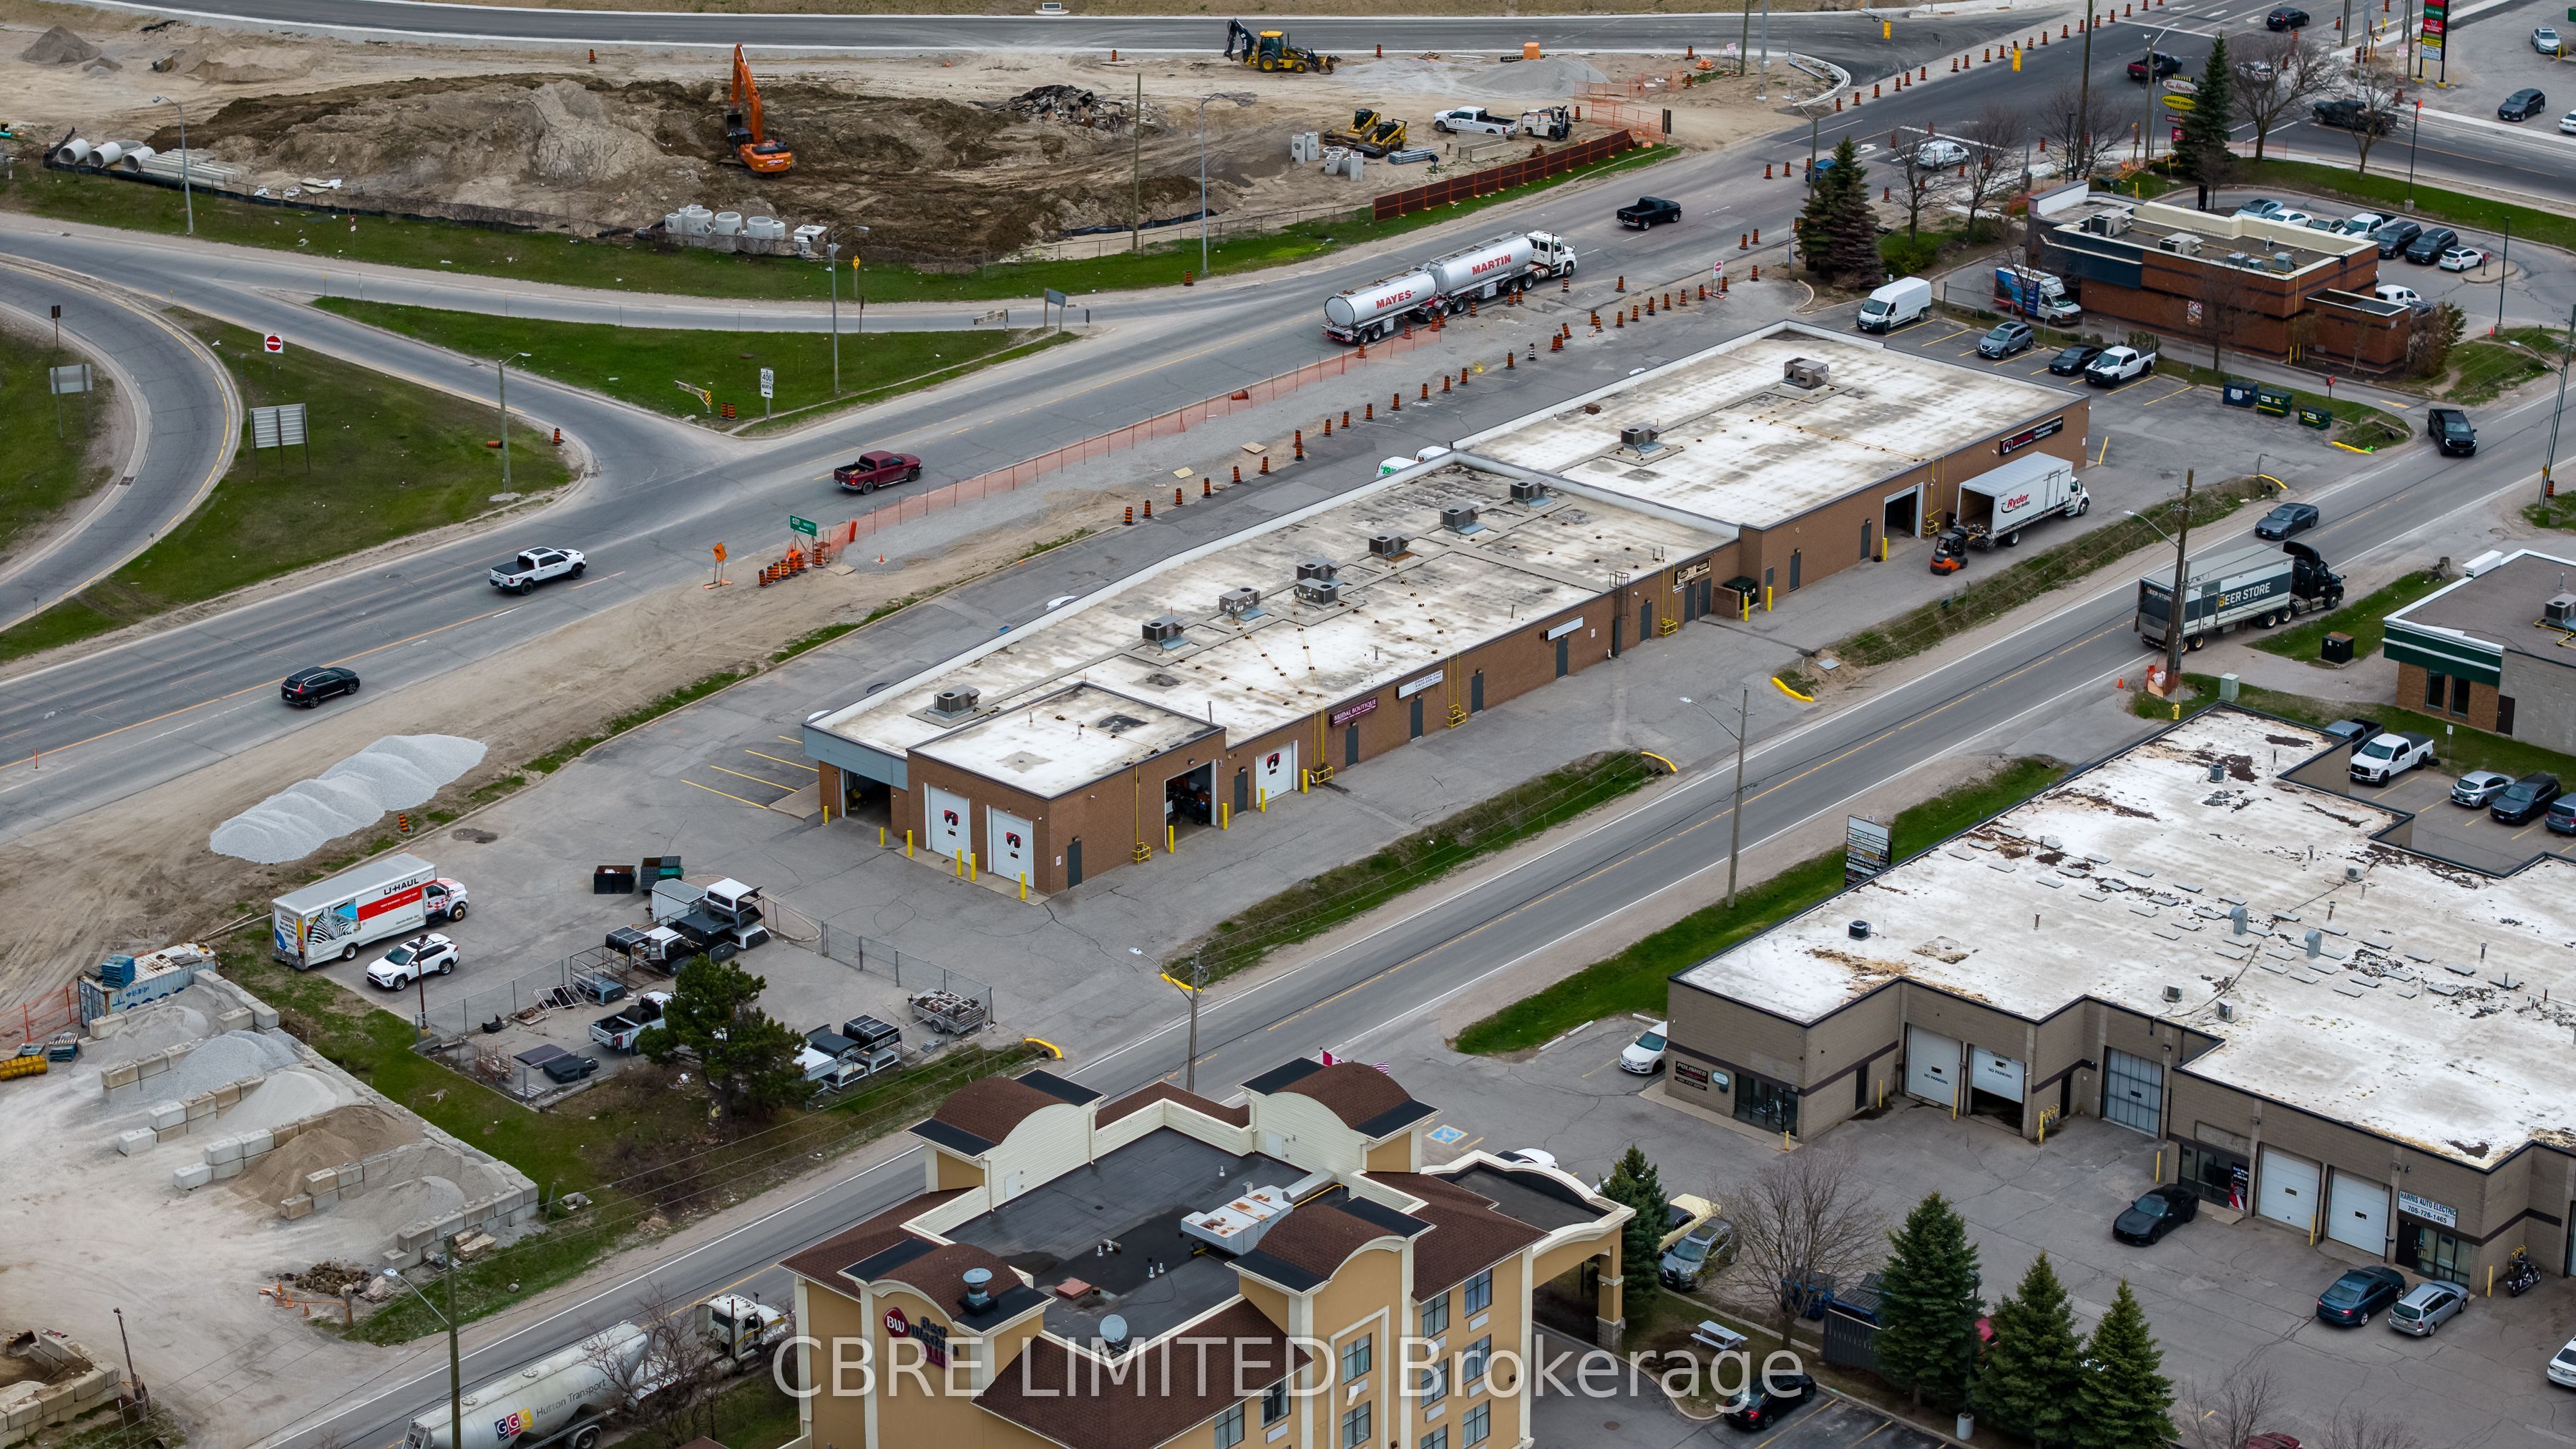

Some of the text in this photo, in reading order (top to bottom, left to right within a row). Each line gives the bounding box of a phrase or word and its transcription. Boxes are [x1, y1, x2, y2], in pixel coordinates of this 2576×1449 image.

[1472, 253, 1511, 275] MARTIN
[762, 374, 772, 382] 400
[2007, 494, 2029, 508] Ryder
[2219, 591, 2242, 607] BEER
[2243, 582, 2271, 600] STORE
[1334, 710, 1352, 721] BRIDAL
[1352, 699, 1376, 713] BOUTIQUE
[384, 878, 419, 895] U-HAUL
[1677, 1063, 1707, 1076] POLISHED
[1995, 1070, 2013, 1079] PARKING
[1931, 1075, 1948, 1085] PARKING
[2400, 1191, 2457, 1216] HARRIS AUTO ELECTRIC
[2408, 1205, 2447, 1224] 705-726-1465
[887, 1315, 904, 1332] BW
[921, 1317, 947, 1337] Best
[536, 1378, 607, 1418] Hutton Transport
